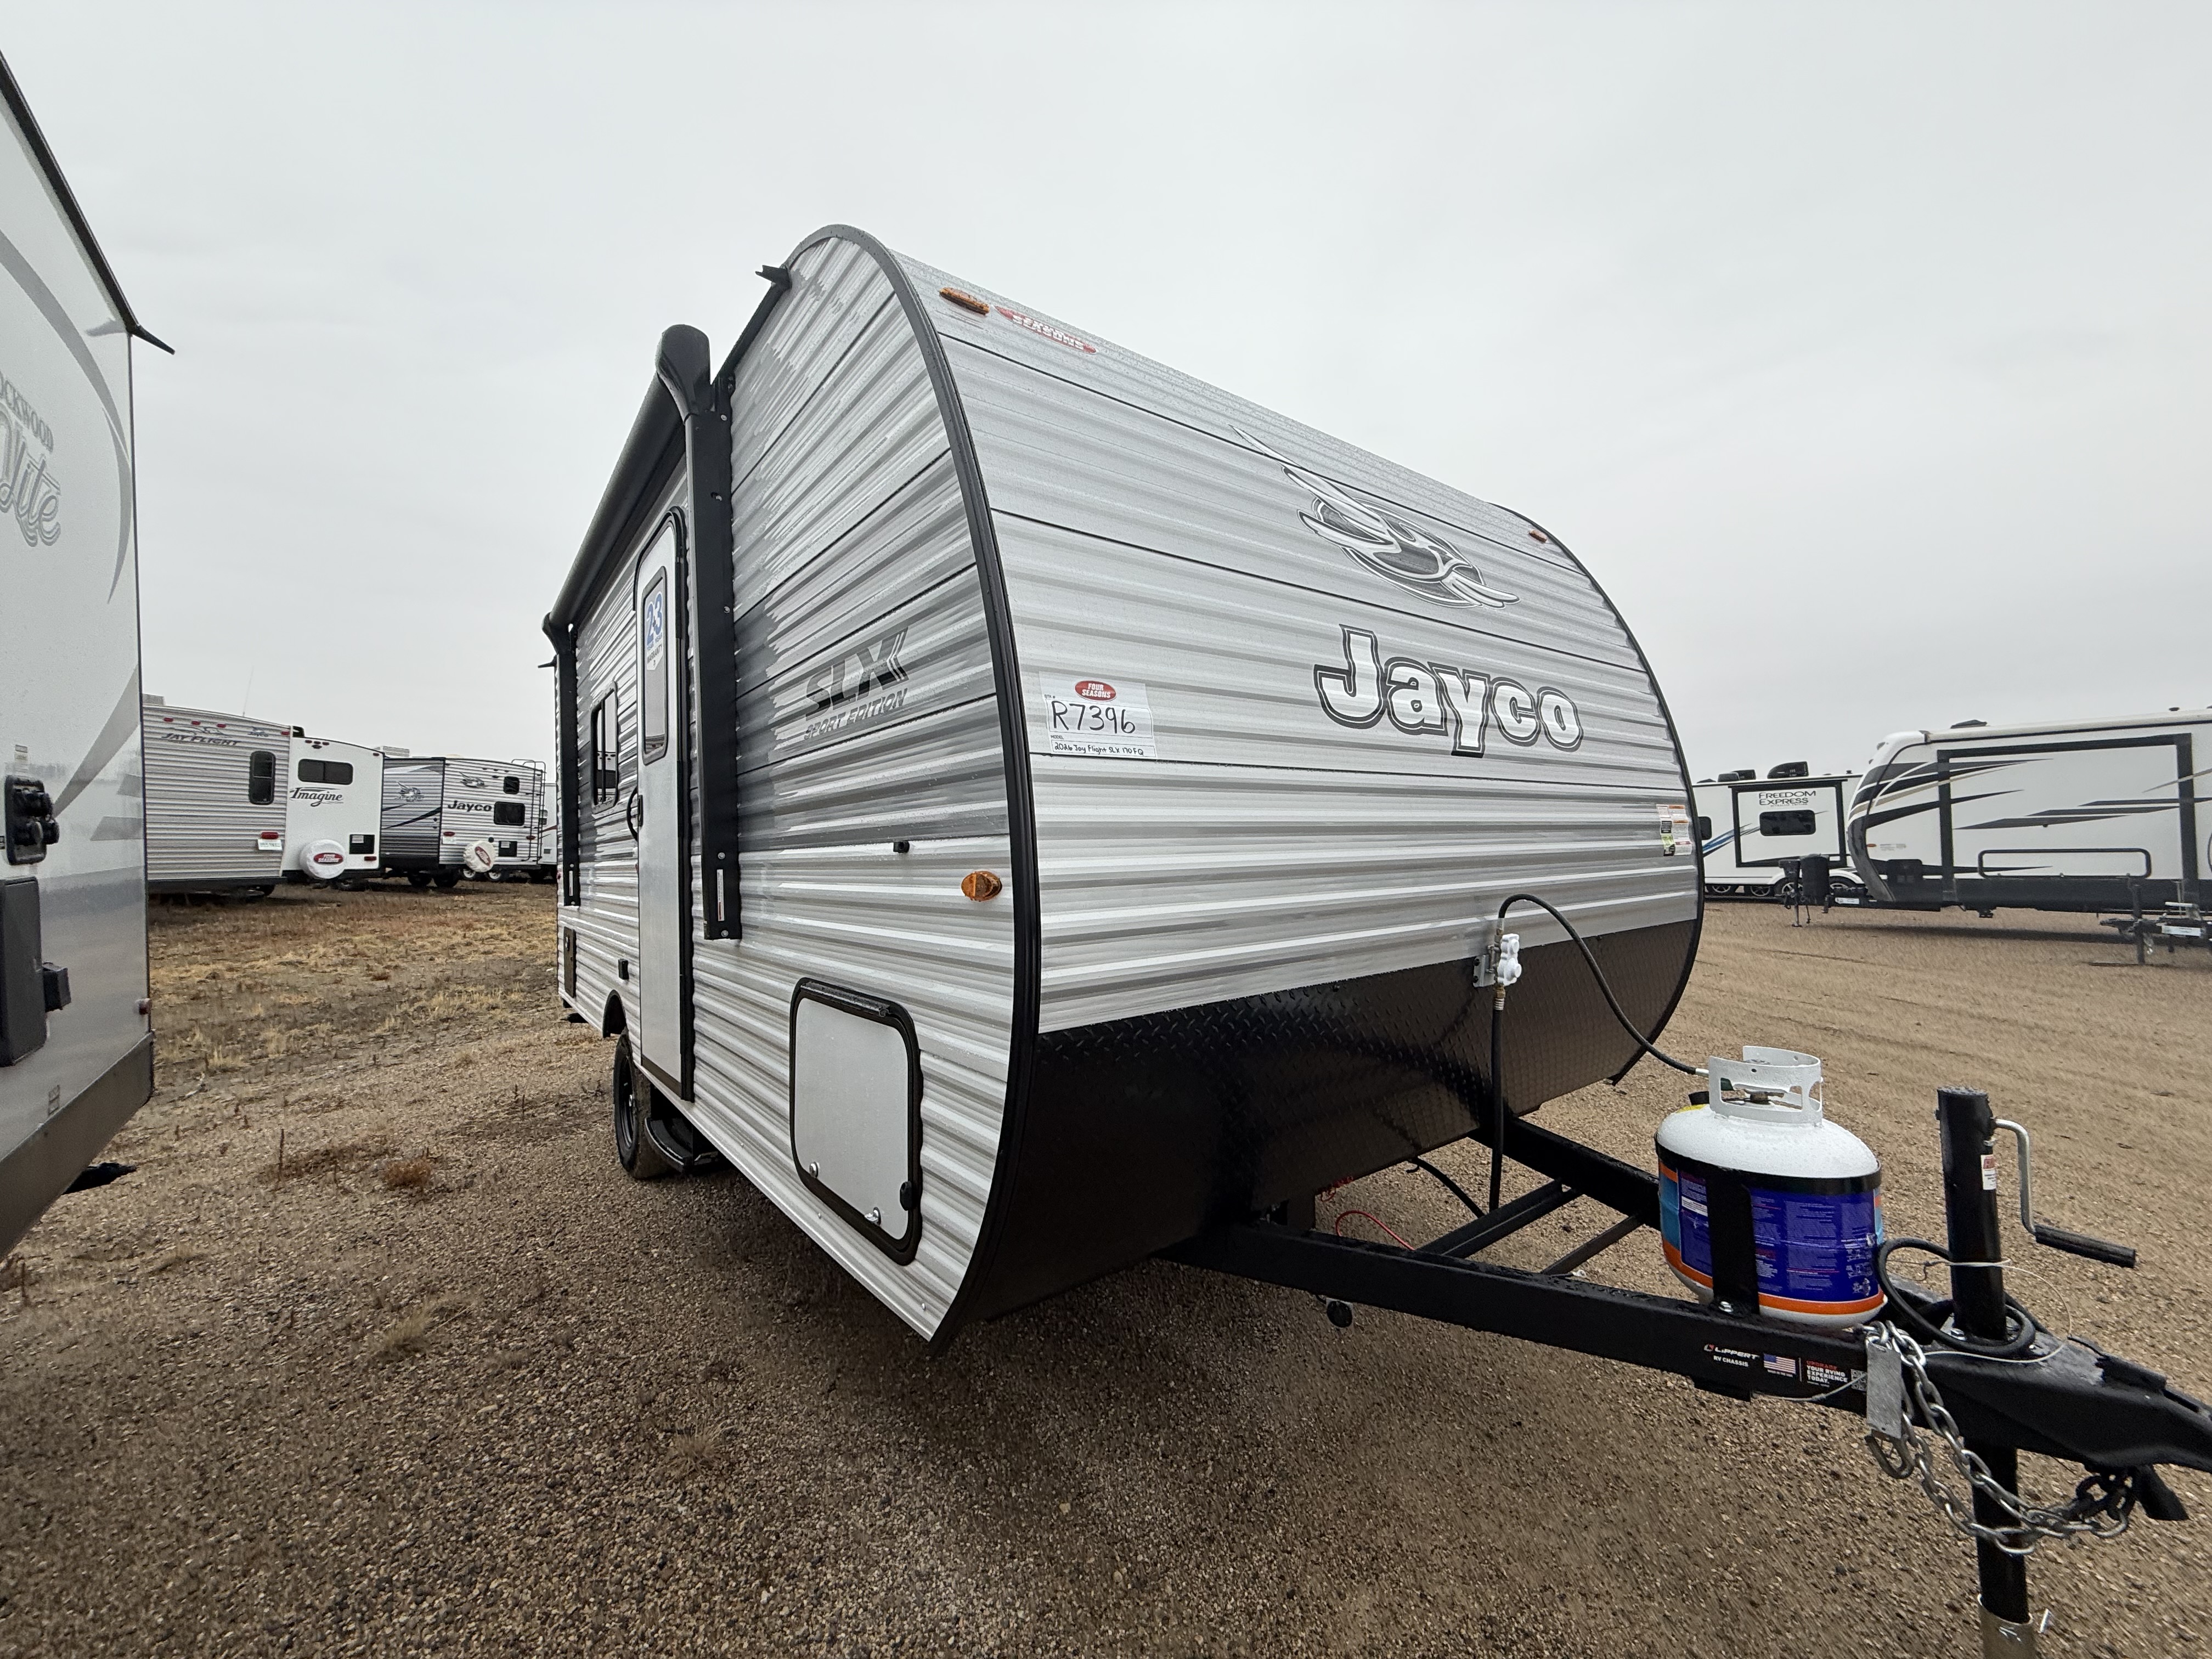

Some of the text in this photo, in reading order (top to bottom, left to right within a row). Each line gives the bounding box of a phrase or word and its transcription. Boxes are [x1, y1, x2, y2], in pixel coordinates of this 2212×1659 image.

[806, 625, 909, 721] SLX
[1088, 683, 1104, 691] FOUR
[1313, 624, 1583, 758] Jayco
[1082, 689, 1111, 698] SEASONS
[804, 688, 908, 740] SPORT EDITION
[1051, 701, 1136, 734] R7396
[191, 736, 241, 746] FLIGHT
[1054, 742, 1073, 751] 2026
[1073, 744, 1086, 753] Jay
[1088, 745, 1107, 755] Flight
[290, 787, 343, 807] Imagine
[1759, 791, 1816, 799] FREEDOM
[448, 800, 492, 812] Jayco
[1759, 798, 1809, 806] EXPRESS
[1715, 1346, 1760, 1359] LIPPERT
[1723, 1358, 1749, 1367] CHASSIS
[1806, 1361, 1838, 1370] UPGRADE
[1807, 1365, 1824, 1373] YOUR
[1807, 1370, 1848, 1383] EXPERIENCE
[1807, 1375, 1830, 1384] TODAY.
